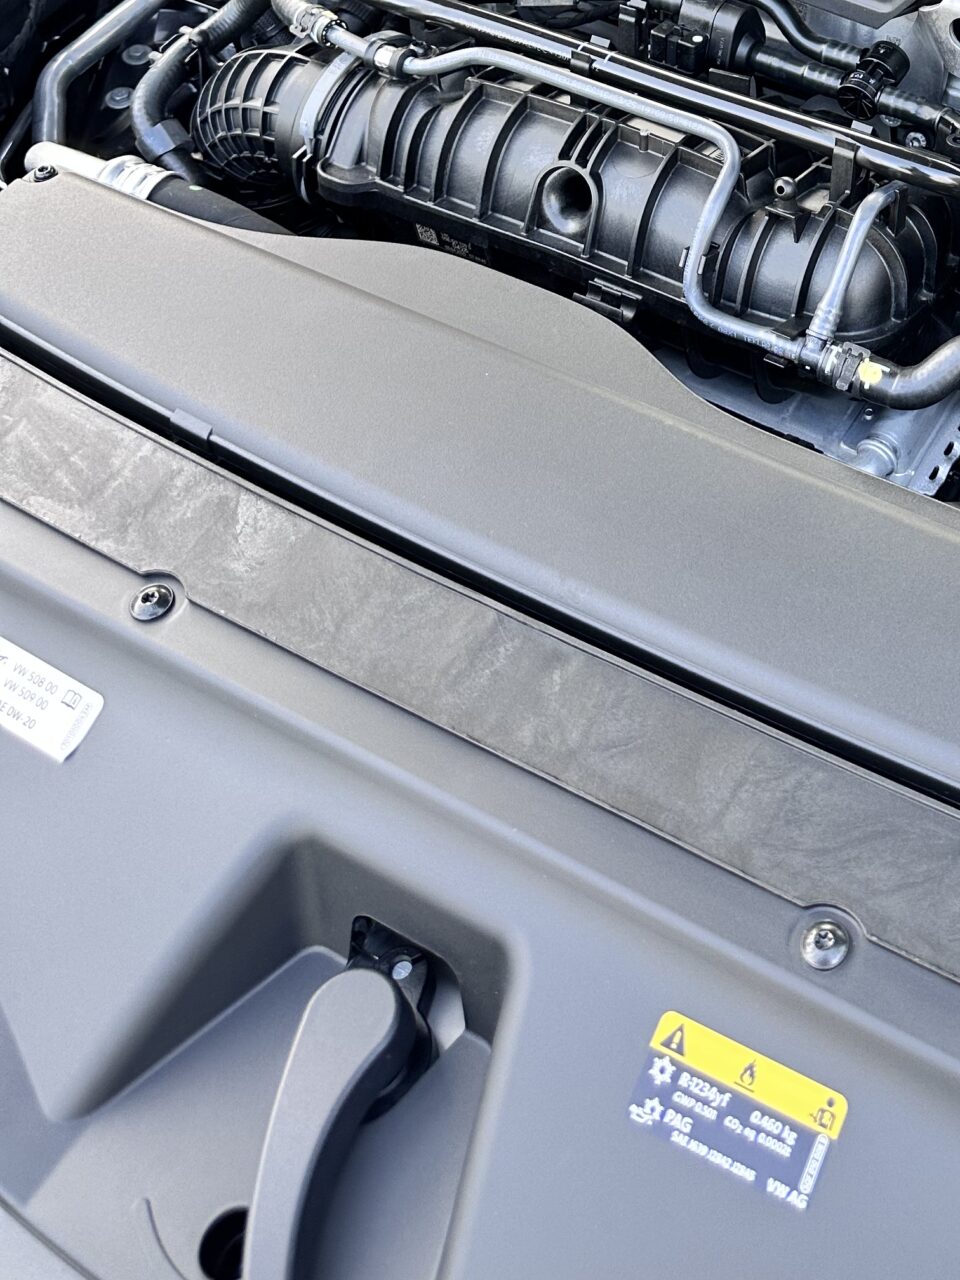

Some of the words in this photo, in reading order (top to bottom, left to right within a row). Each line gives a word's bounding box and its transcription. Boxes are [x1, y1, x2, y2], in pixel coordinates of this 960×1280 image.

[3, 678, 19, 692] VW
[35, 696, 49, 711] 00
[13, 663, 28, 677] VW
[45, 680, 59, 695] 00
[663, 1108, 694, 1134] PAG
[677, 1071, 732, 1107] R-1234yf
[780, 1124, 798, 1146] kg
[766, 1177, 791, 1199] VW
[785, 1189, 809, 1209] AG
